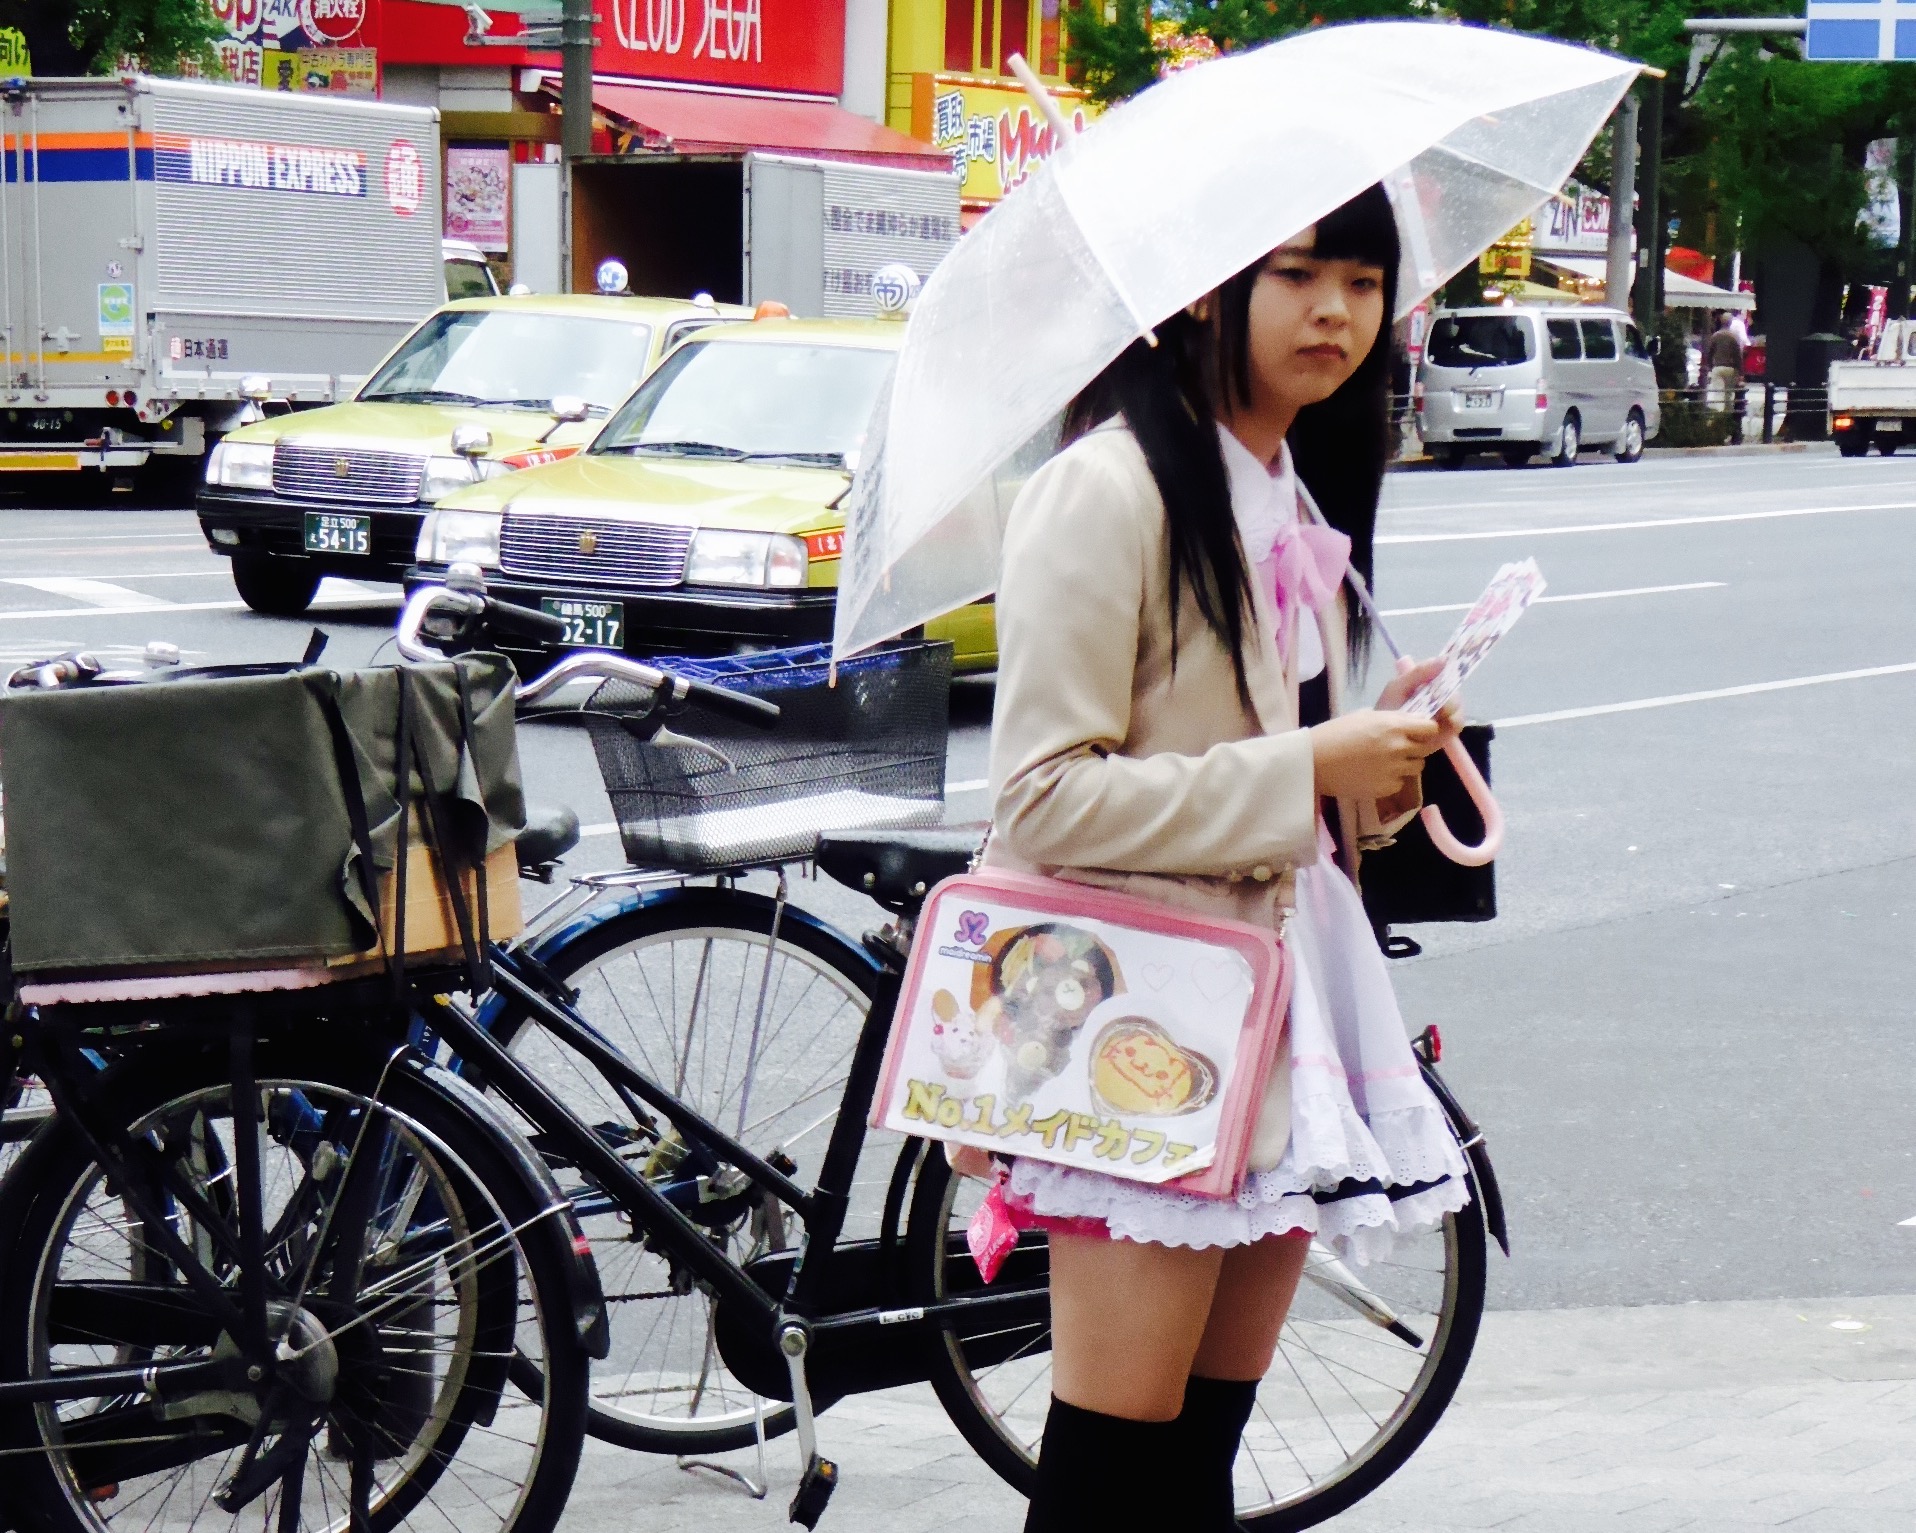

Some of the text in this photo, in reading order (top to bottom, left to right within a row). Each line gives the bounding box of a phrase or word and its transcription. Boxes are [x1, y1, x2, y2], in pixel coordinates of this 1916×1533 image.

[191, 139, 362, 196] NIPPON EXPRESS
[319, 528, 368, 551] 54-15
